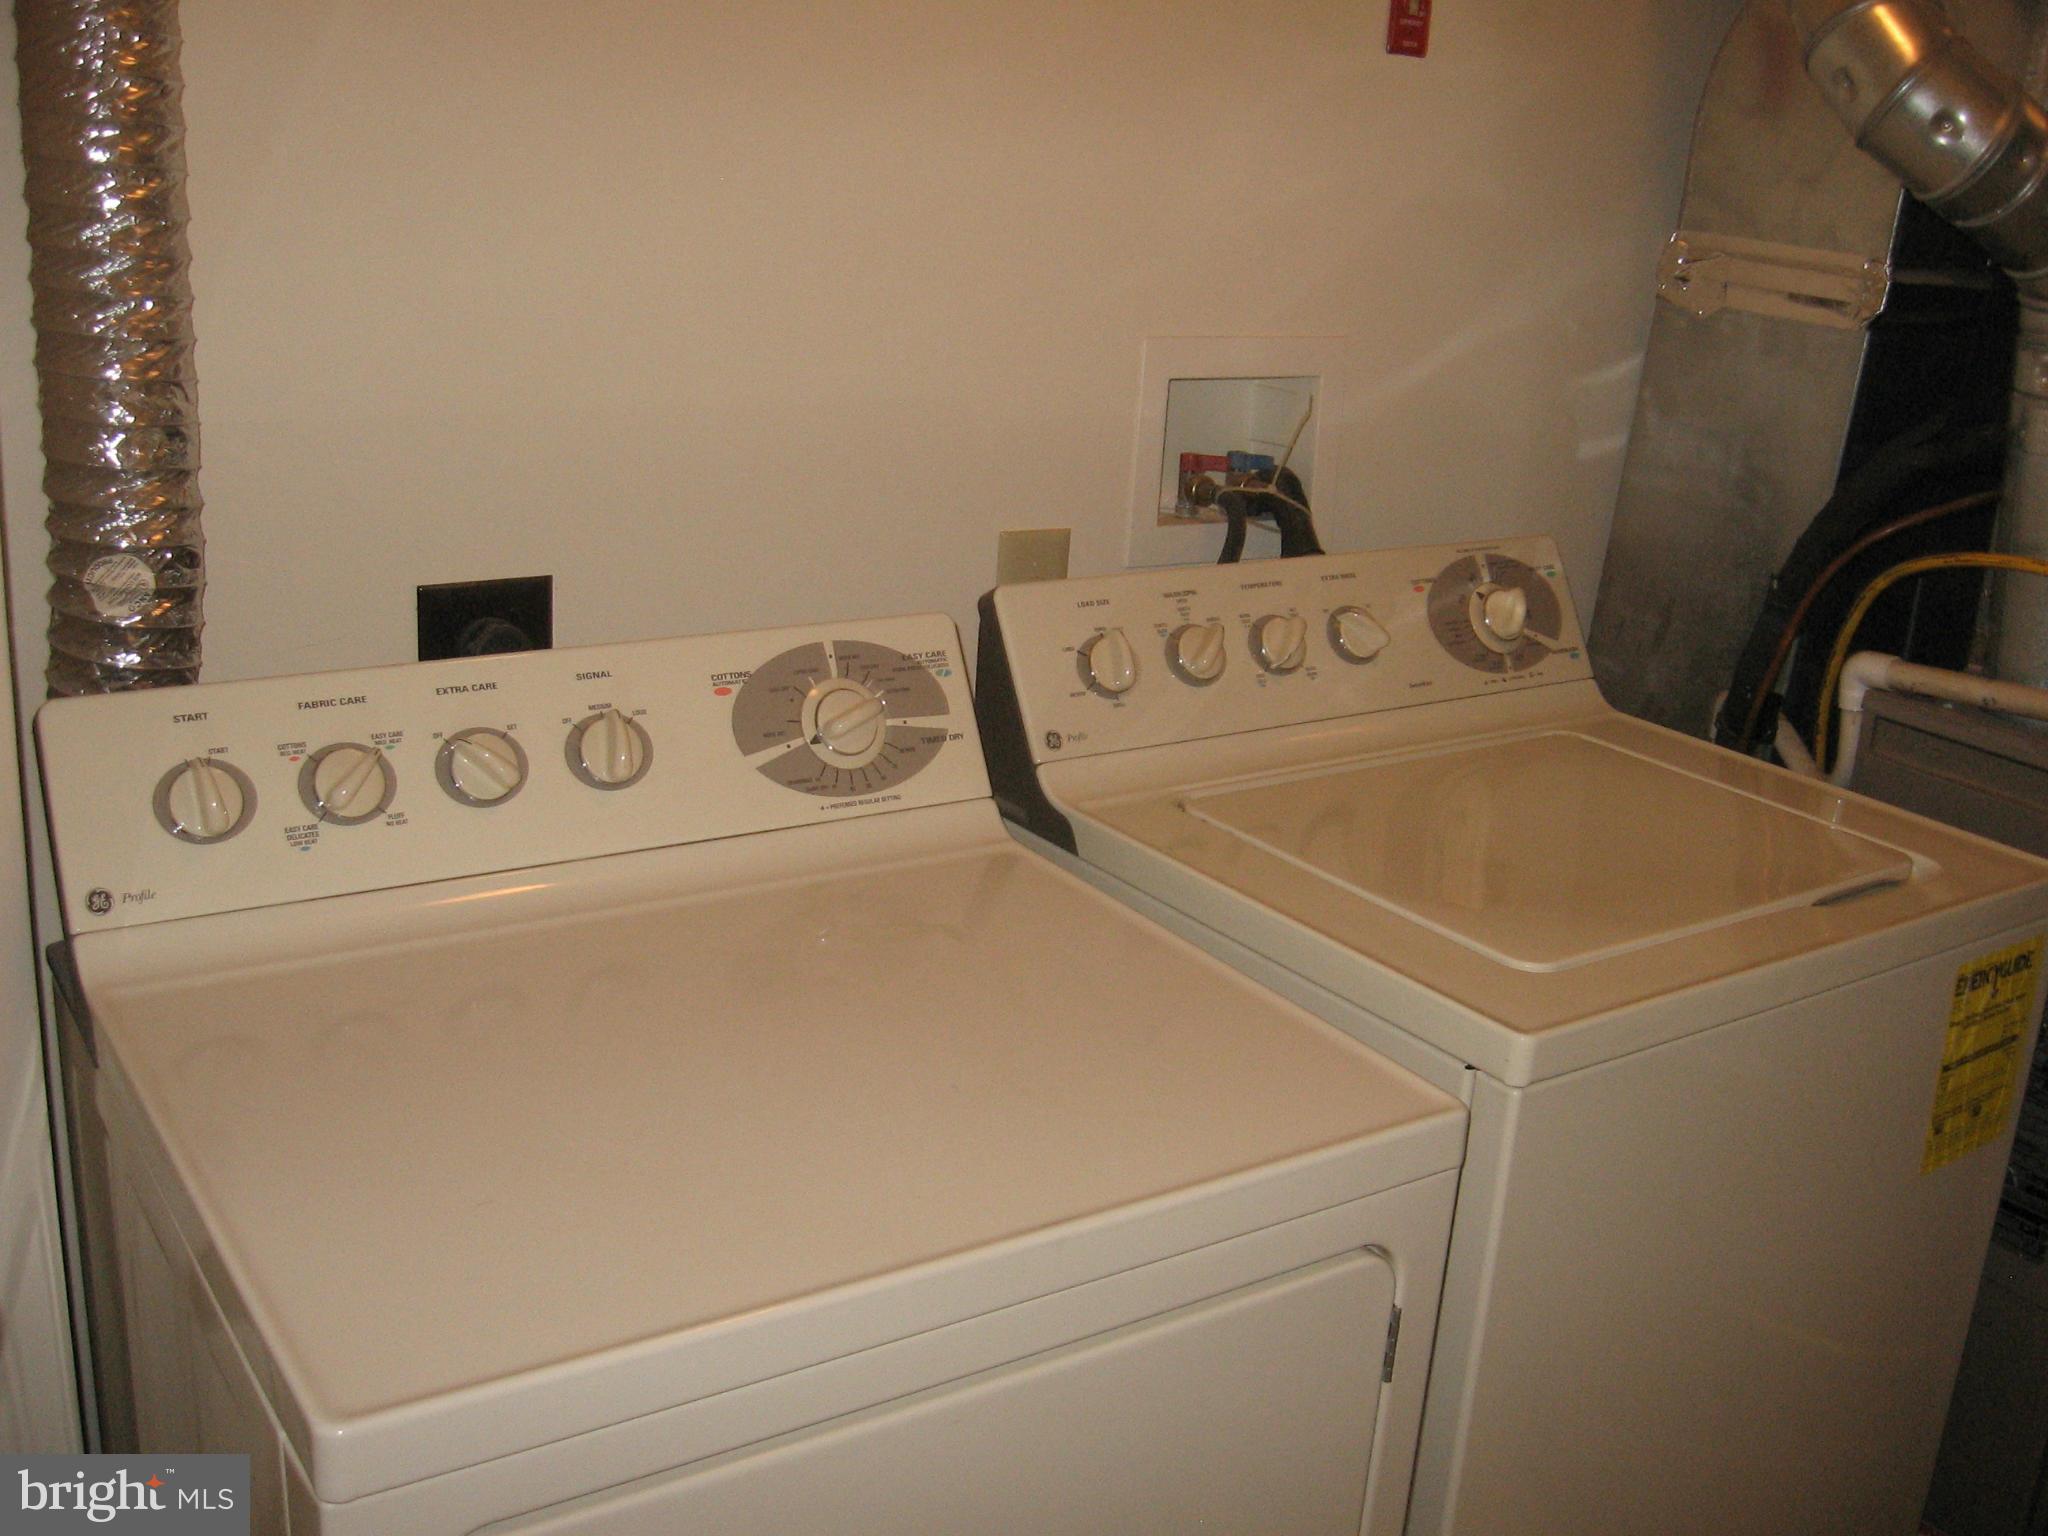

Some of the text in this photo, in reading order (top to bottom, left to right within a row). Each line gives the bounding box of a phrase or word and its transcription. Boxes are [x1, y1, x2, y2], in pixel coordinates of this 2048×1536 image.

[1077, 600, 1095, 608] LOAD
[902, 649, 947, 662] EASY CARE
[575, 670, 613, 681] SIGNAL
[710, 671, 752, 682] COTTONS
[435, 681, 498, 696] EXTRA CARE
[297, 695, 368, 710] FABRIC CARE
[173, 712, 210, 724] START
[371, 730, 404, 741] EASY CARE
[921, 732, 965, 745] TIMED DRY
[208, 746, 230, 755] START
[277, 741, 307, 751] COTTONS
[120, 889, 157, 904] Profile
